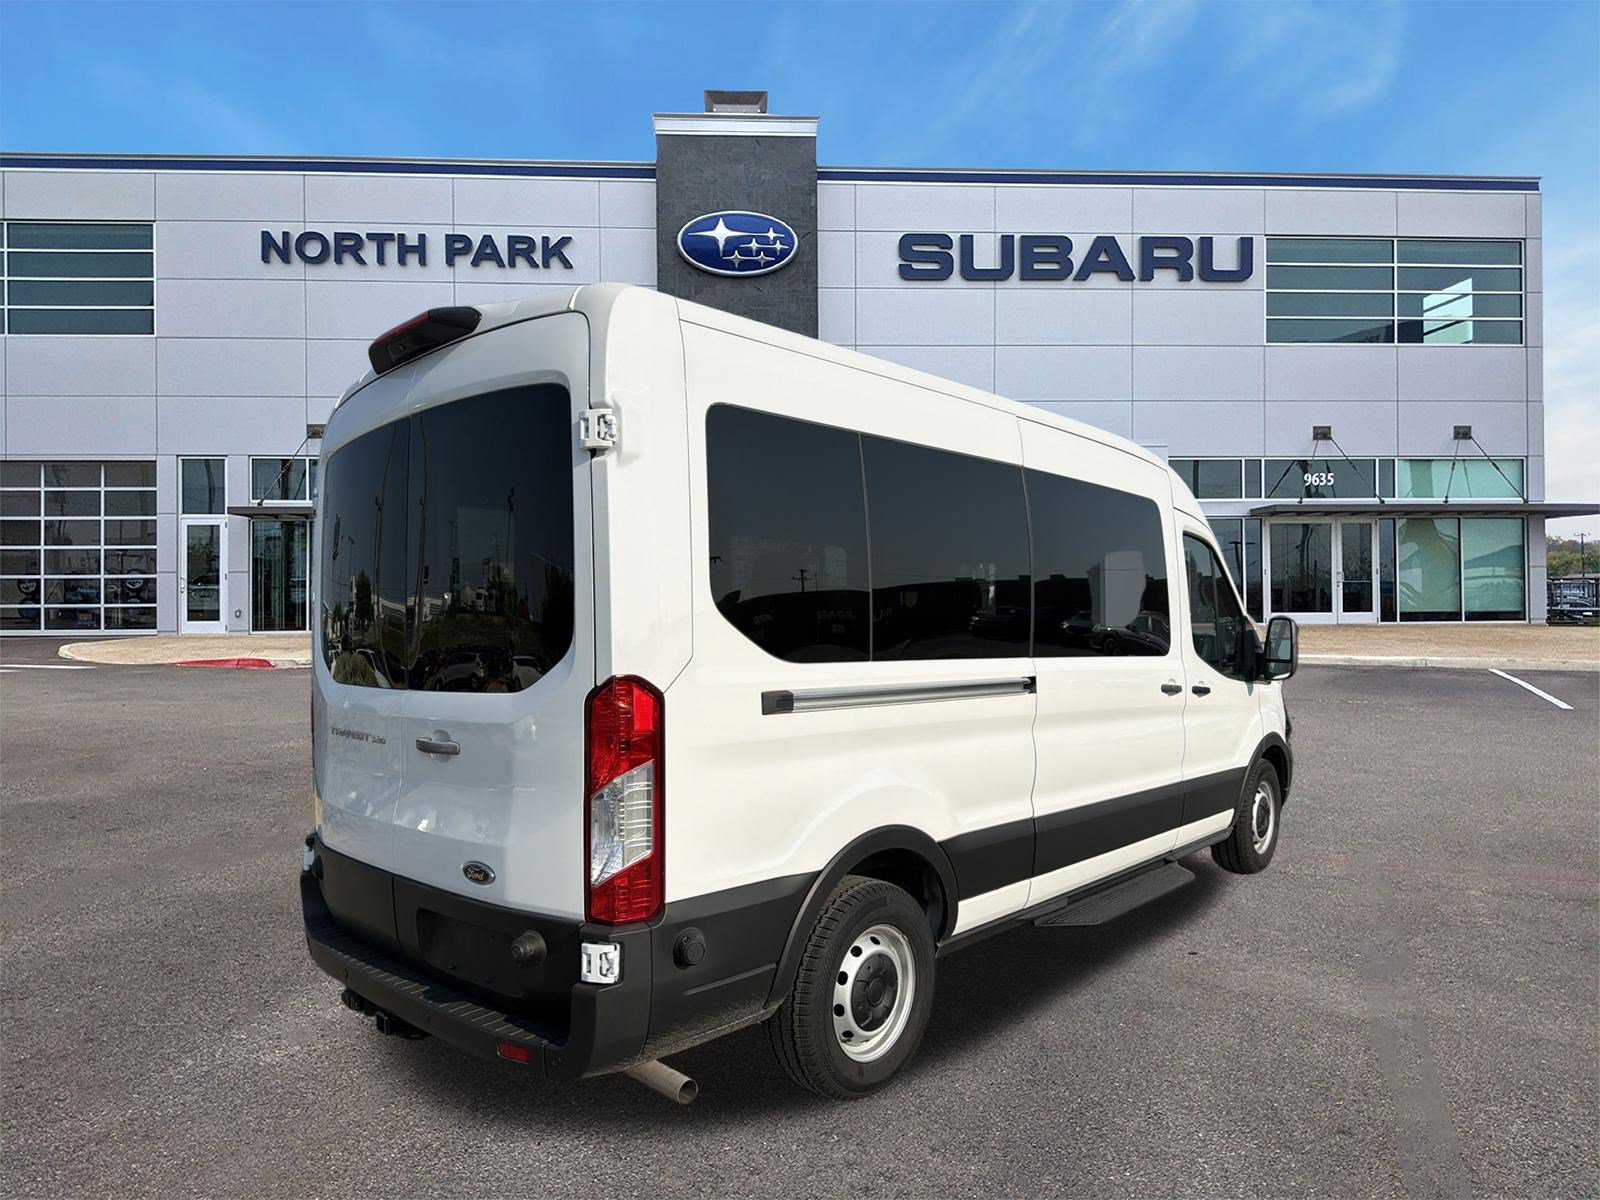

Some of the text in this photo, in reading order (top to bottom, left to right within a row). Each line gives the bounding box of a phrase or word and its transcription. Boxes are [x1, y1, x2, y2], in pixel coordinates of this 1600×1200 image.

[261, 231, 574, 269] NORTH PARK
[898, 233, 1254, 282] SUBARU
[1303, 472, 1335, 487] 9635
